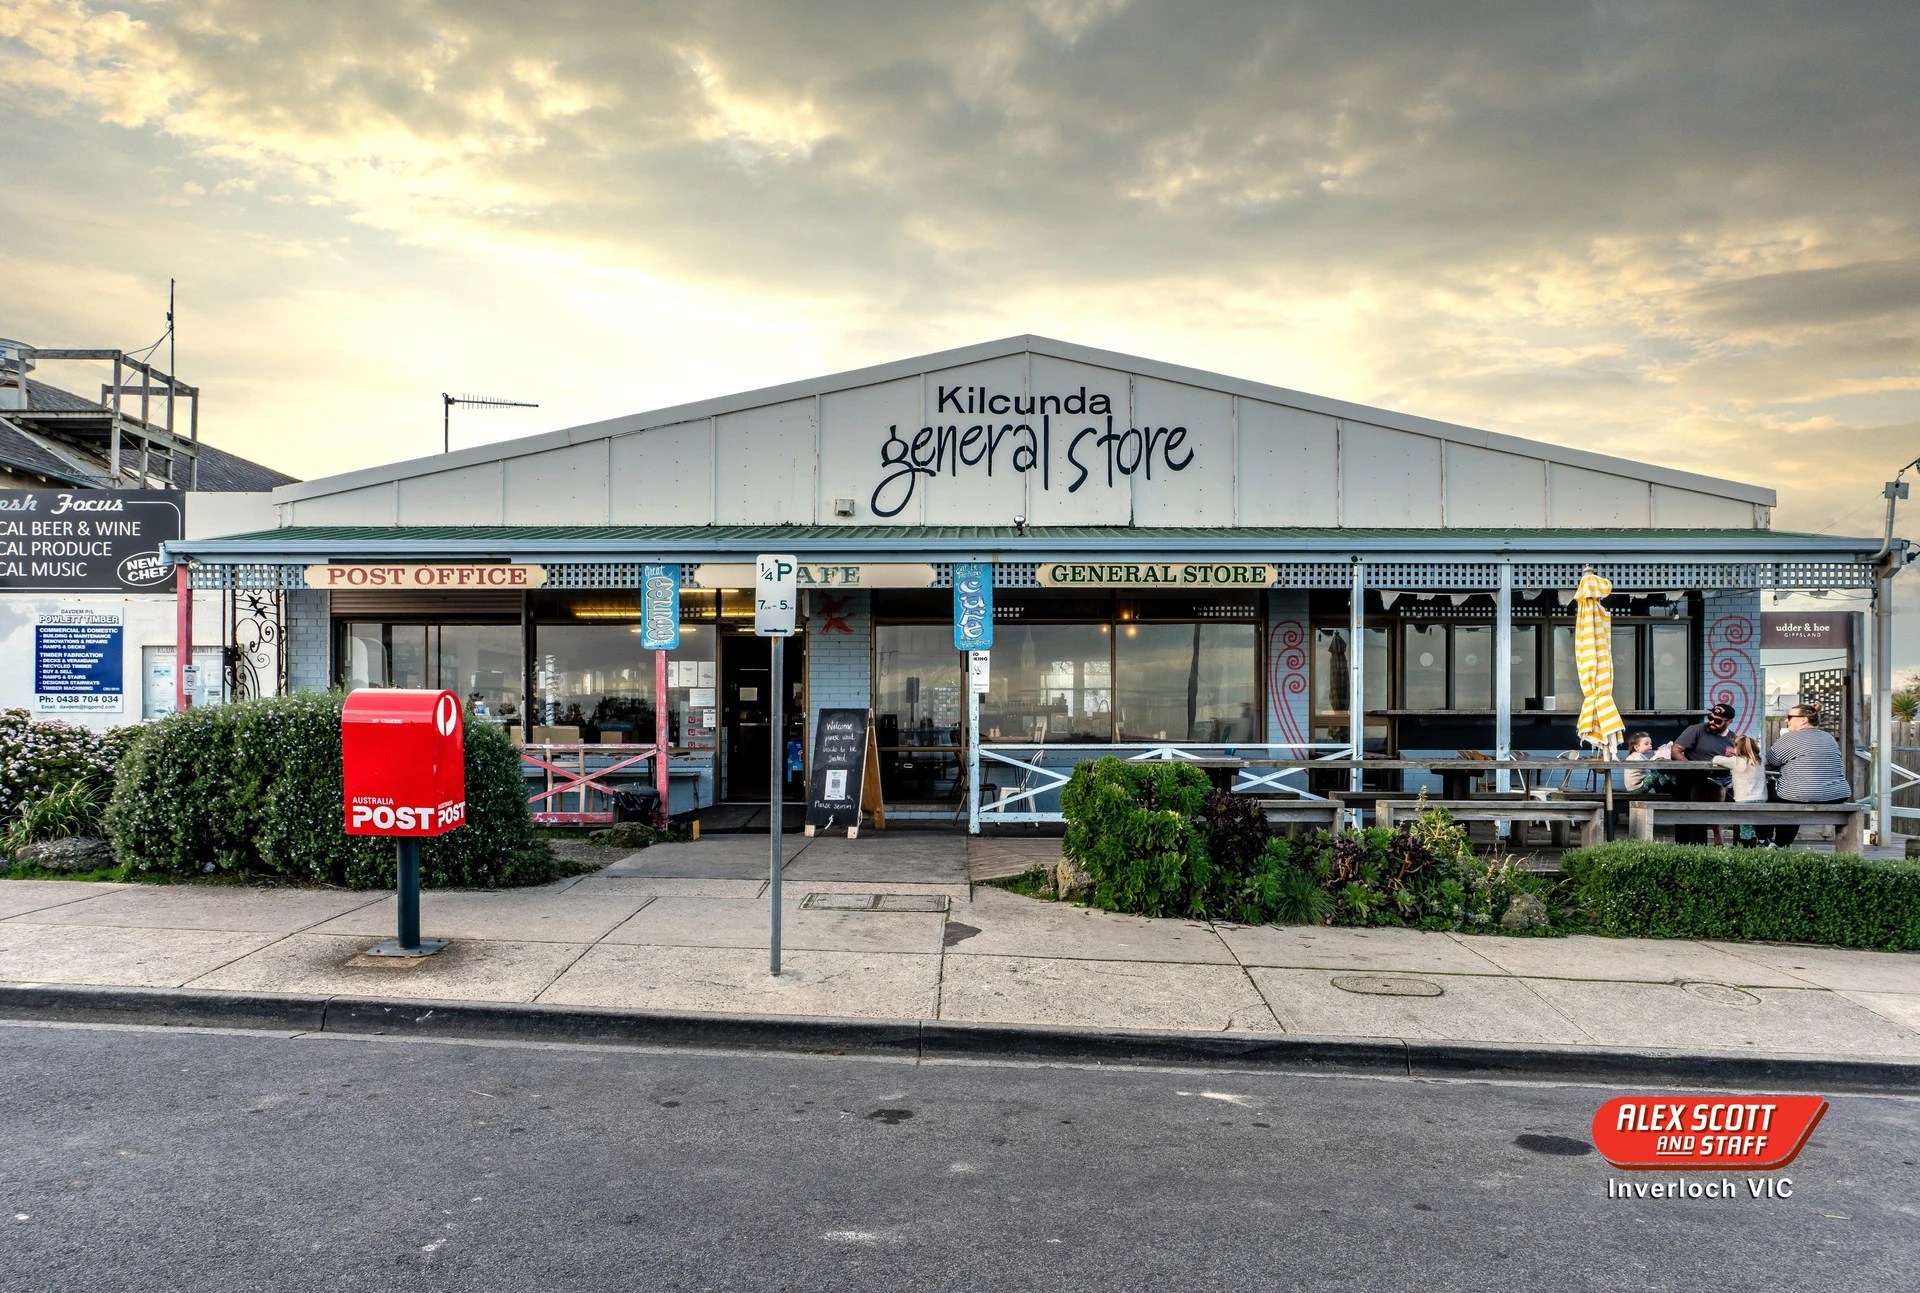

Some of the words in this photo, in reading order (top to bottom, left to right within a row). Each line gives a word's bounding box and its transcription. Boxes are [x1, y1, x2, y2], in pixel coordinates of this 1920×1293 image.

[938, 386, 1111, 415] Kilcunda
[871, 414, 1049, 518] general
[1068, 415, 1195, 493] store
[0, 494, 37, 512] esh
[51, 493, 124, 515] Focus
[0, 521, 27, 537] CAL
[32, 521, 73, 537] BEER
[77, 521, 91, 537] &
[95, 521, 141, 537] WINE
[0, 541, 27, 557] CAL
[32, 541, 112, 557] PRODUCE
[0, 561, 27, 577] CAL
[32, 561, 88, 577] MUSIC
[127, 556, 162, 571] NEW
[127, 566, 168, 582] CHEF
[327, 567, 406, 586] POST
[414, 567, 528, 586] OFFICE
[796, 566, 861, 585] AFE
[1050, 564, 1177, 584] GENERAL
[1183, 564, 1267, 584] STORE
[39, 615, 82, 624] POWLETT
[84, 615, 120, 624] TIMBER
[1776, 623, 1803, 632] udder
[1804, 623, 1811, 632] &
[1813, 623, 1830, 632] hoe
[826, 721, 853, 731] Welcome
[352, 796, 394, 805] AUSTRALIA
[352, 806, 435, 830] POST
[438, 801, 466, 828] POST
